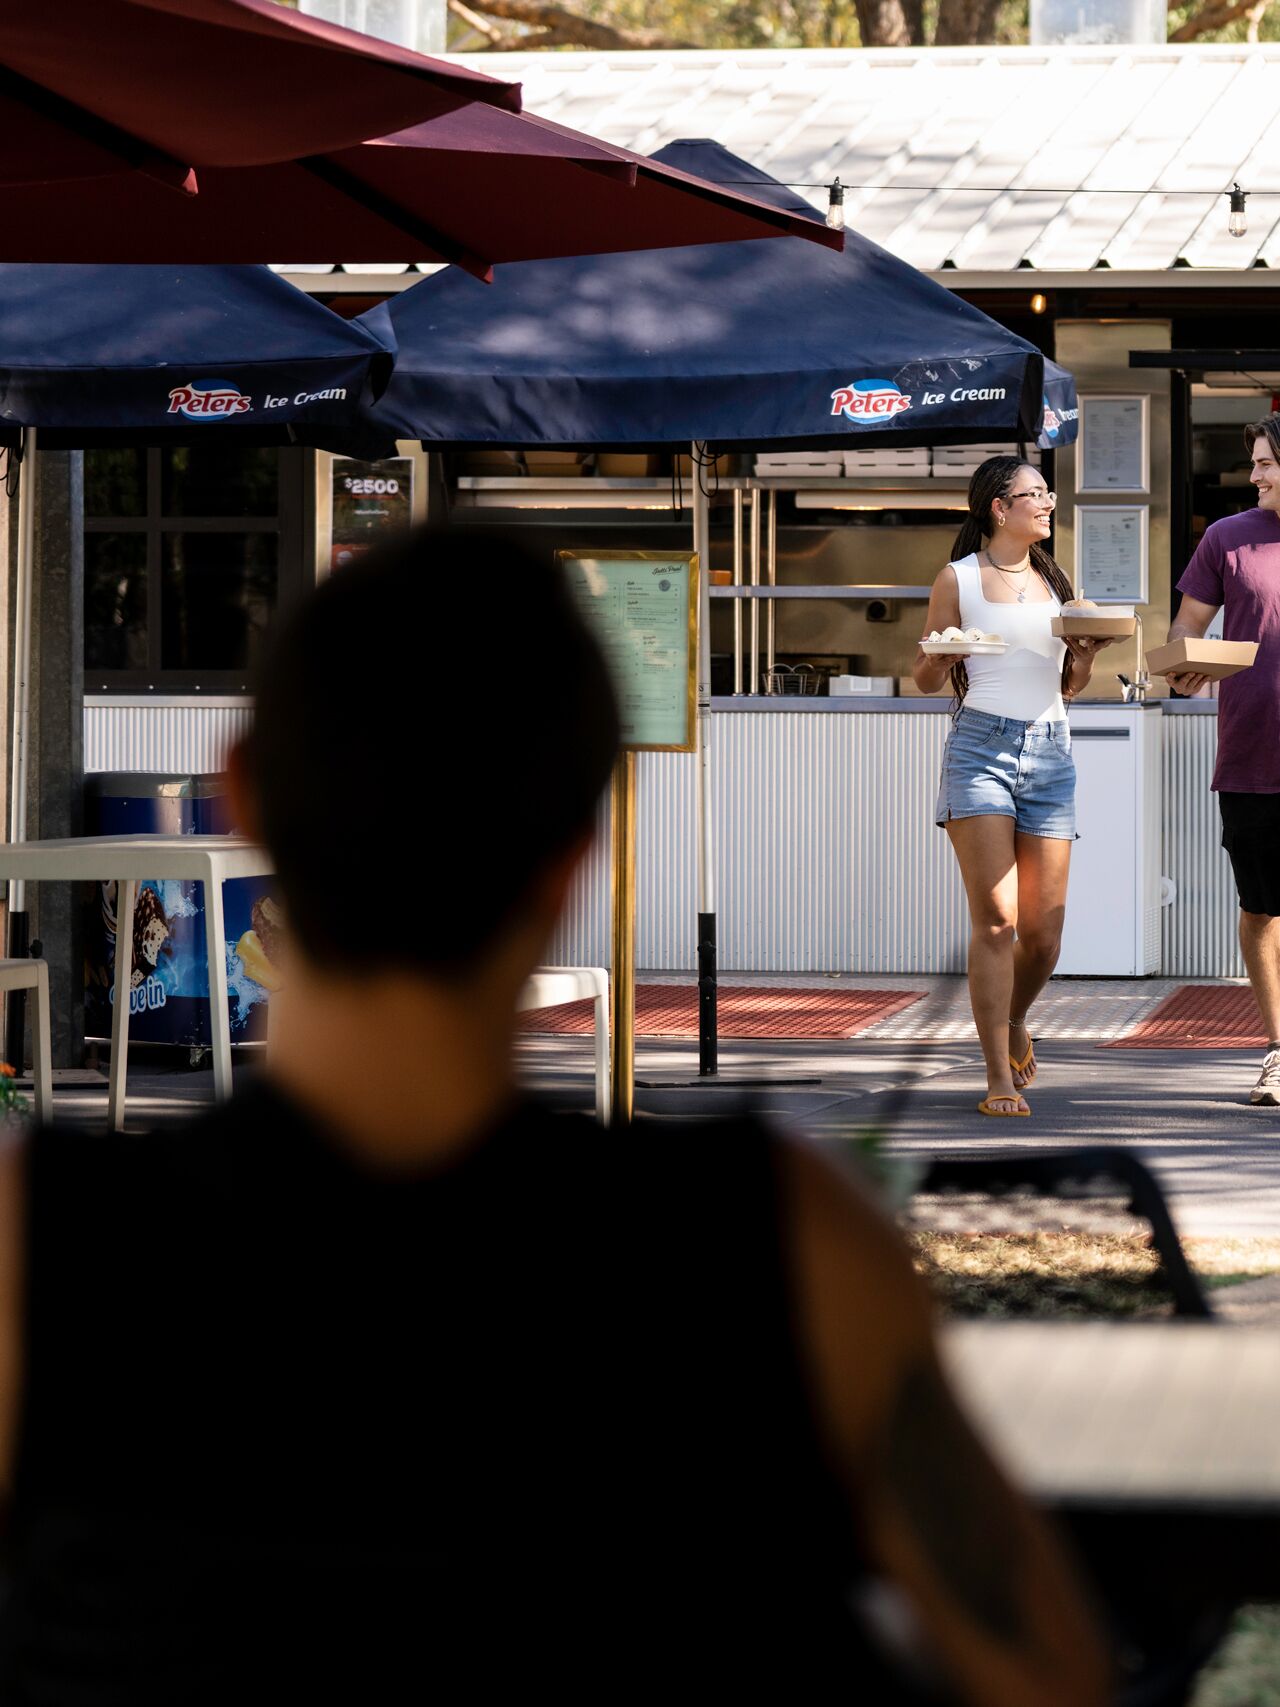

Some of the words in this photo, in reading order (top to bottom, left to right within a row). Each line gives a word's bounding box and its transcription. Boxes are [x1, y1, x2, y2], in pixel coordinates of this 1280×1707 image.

[167, 386, 251, 413] Peters
[264, 394, 288, 408] Ice
[293, 388, 347, 406] Cream
[831, 390, 912, 415] Peters
[922, 391, 945, 405] Ice
[950, 387, 1006, 402] Cream
[344, 477, 399, 494] $2500
[147, 975, 166, 1010] in
